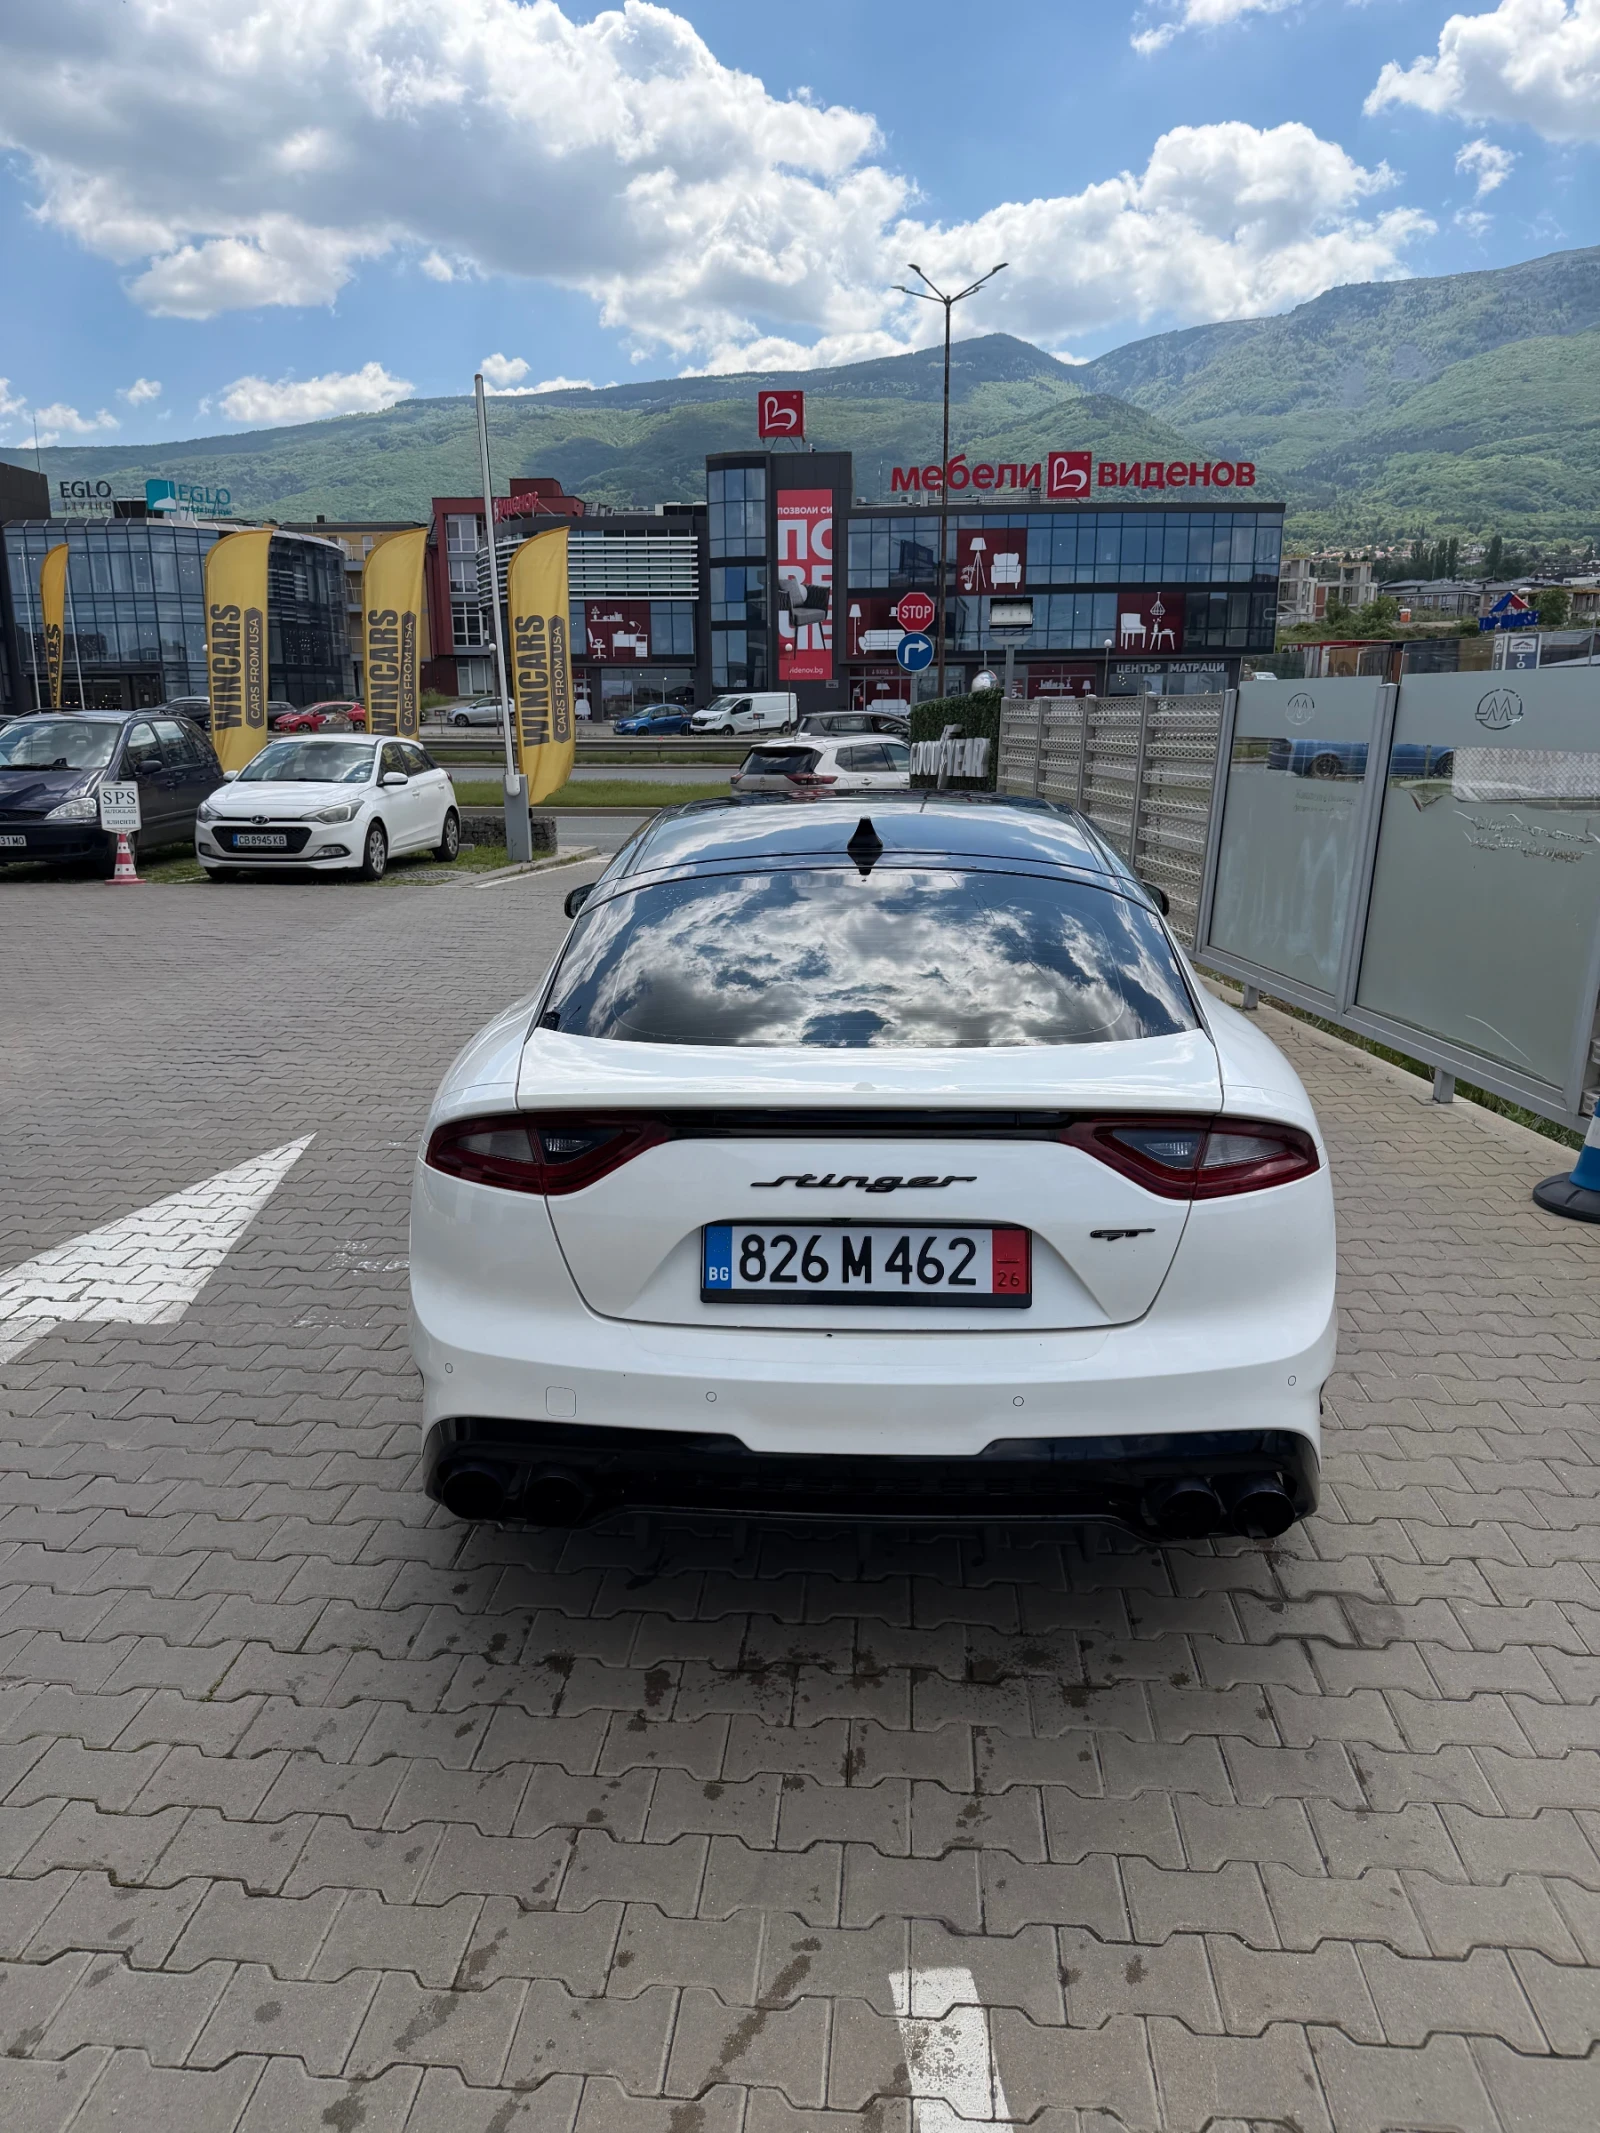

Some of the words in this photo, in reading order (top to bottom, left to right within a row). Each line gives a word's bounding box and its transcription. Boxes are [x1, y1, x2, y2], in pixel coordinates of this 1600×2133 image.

[890, 453, 1042, 491] мебели
[1099, 461, 1256, 489] виденов
[60, 480, 112, 498] EGLO
[179, 484, 231, 505] EGLO
[778, 507, 818, 515] ПОЗВОЛИ
[820, 505, 832, 514] СИ
[901, 605, 932, 619] STOP
[249, 617, 259, 643] USA
[403, 621, 413, 648] USA
[553, 626, 562, 654] USA
[209, 603, 243, 731] WINCARS
[249, 647, 260, 684] FROM
[368, 609, 399, 736] WINCARS
[403, 653, 413, 690] FROM
[554, 658, 565, 696] FROM
[1116, 663, 1161, 674] ЦЕНТЪР
[1169, 662, 1225, 673] МАТРАЦИ
[515, 614, 550, 747] WINCARS
[249, 687, 261, 719] CARS
[403, 693, 413, 726] CARS
[556, 699, 566, 733] CARS
[103, 791, 136, 805] SPS
[750, 1174, 977, 1193] stinger
[708, 1266, 729, 1281] BG
[739, 1234, 829, 1284] 826
[842, 1235, 872, 1284] M
[884, 1237, 977, 1286] 462
[997, 1270, 1020, 1288] 26
